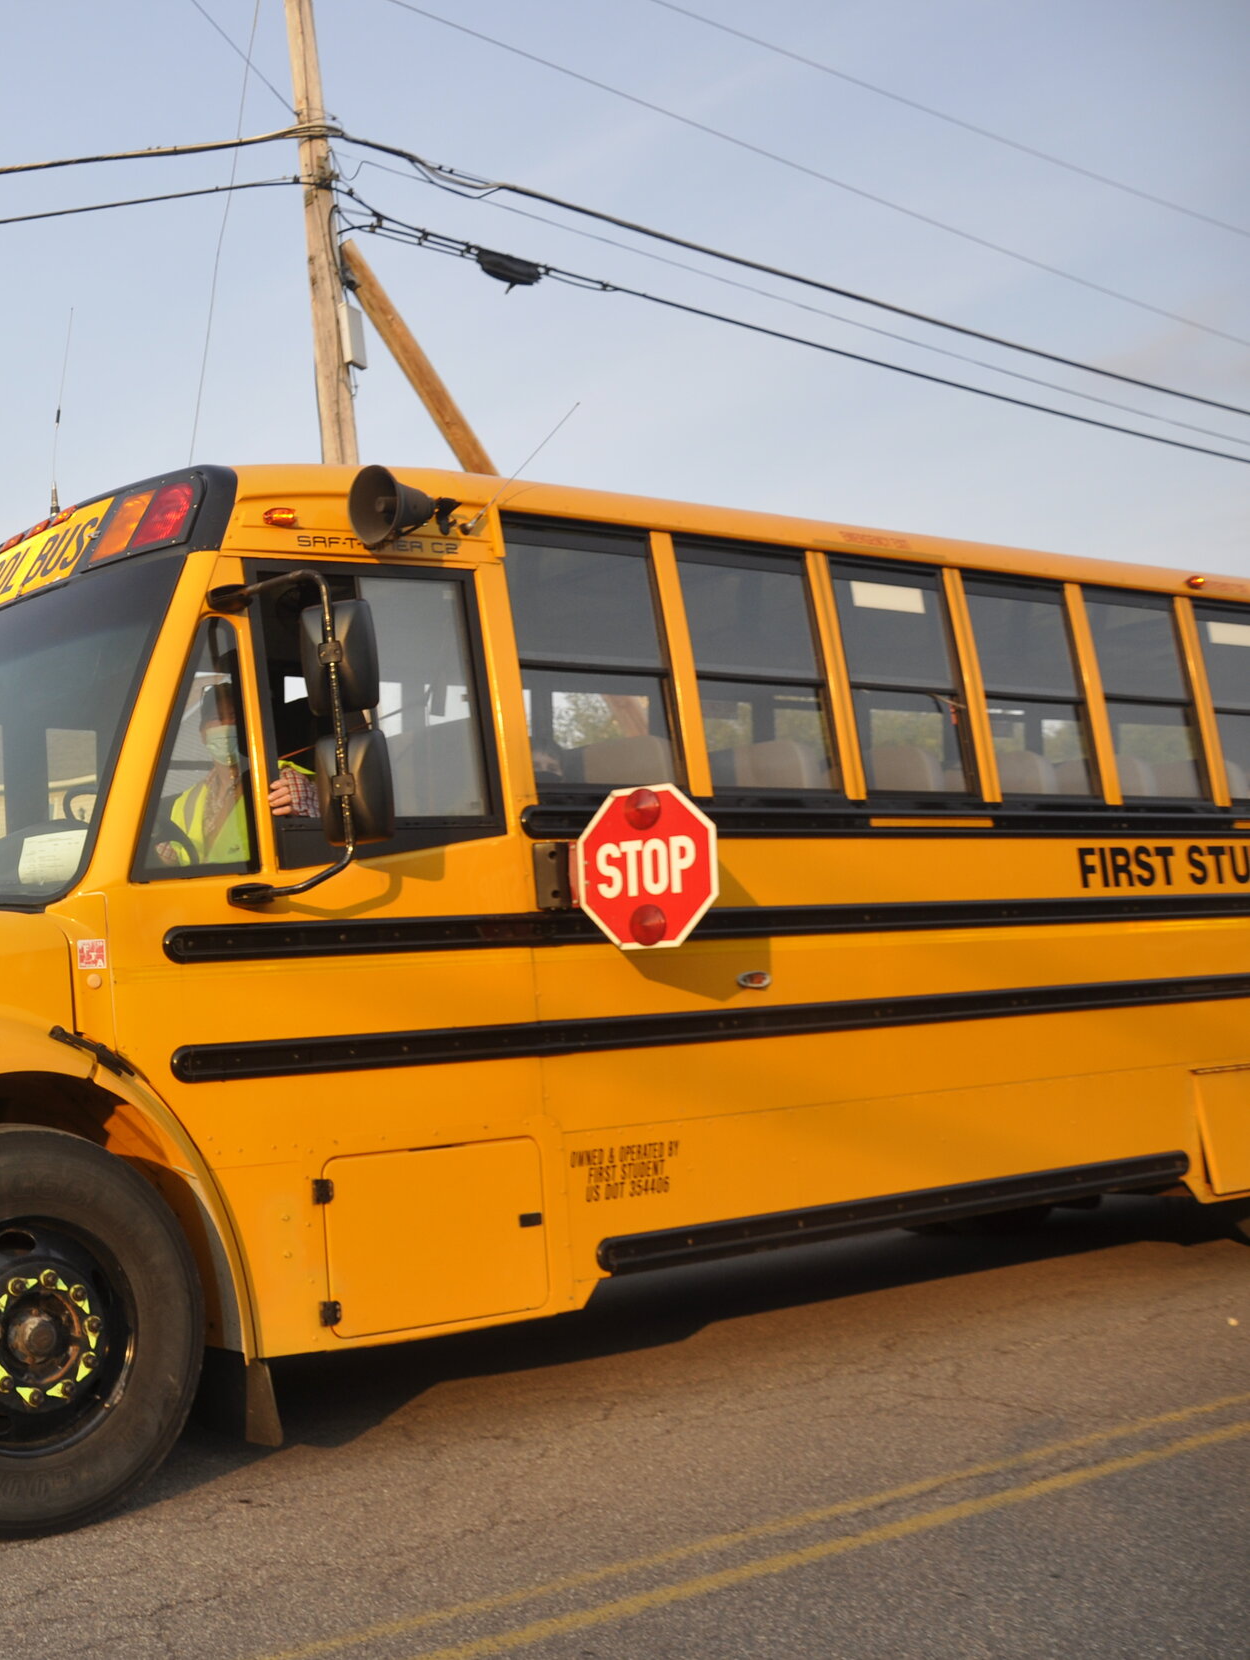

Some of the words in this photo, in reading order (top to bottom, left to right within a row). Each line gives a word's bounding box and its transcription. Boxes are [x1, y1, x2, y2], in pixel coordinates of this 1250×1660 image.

[23, 517, 99, 586] BUS
[431, 542, 458, 554] C2
[596, 835, 696, 899] STOP
[1077, 845, 1175, 888] FIRST
[1187, 845, 1250, 885] STU
[570, 1148, 604, 1168] OWNED
[608, 1147, 615, 1164] &
[618, 1142, 664, 1163] OPERATED
[668, 1140, 679, 1157] BY
[588, 1164, 617, 1184] FIRST
[621, 1159, 665, 1180] STUDENT
[586, 1184, 601, 1203] US
[605, 1181, 625, 1201] DOT
[629, 1176, 670, 1198] 354406
